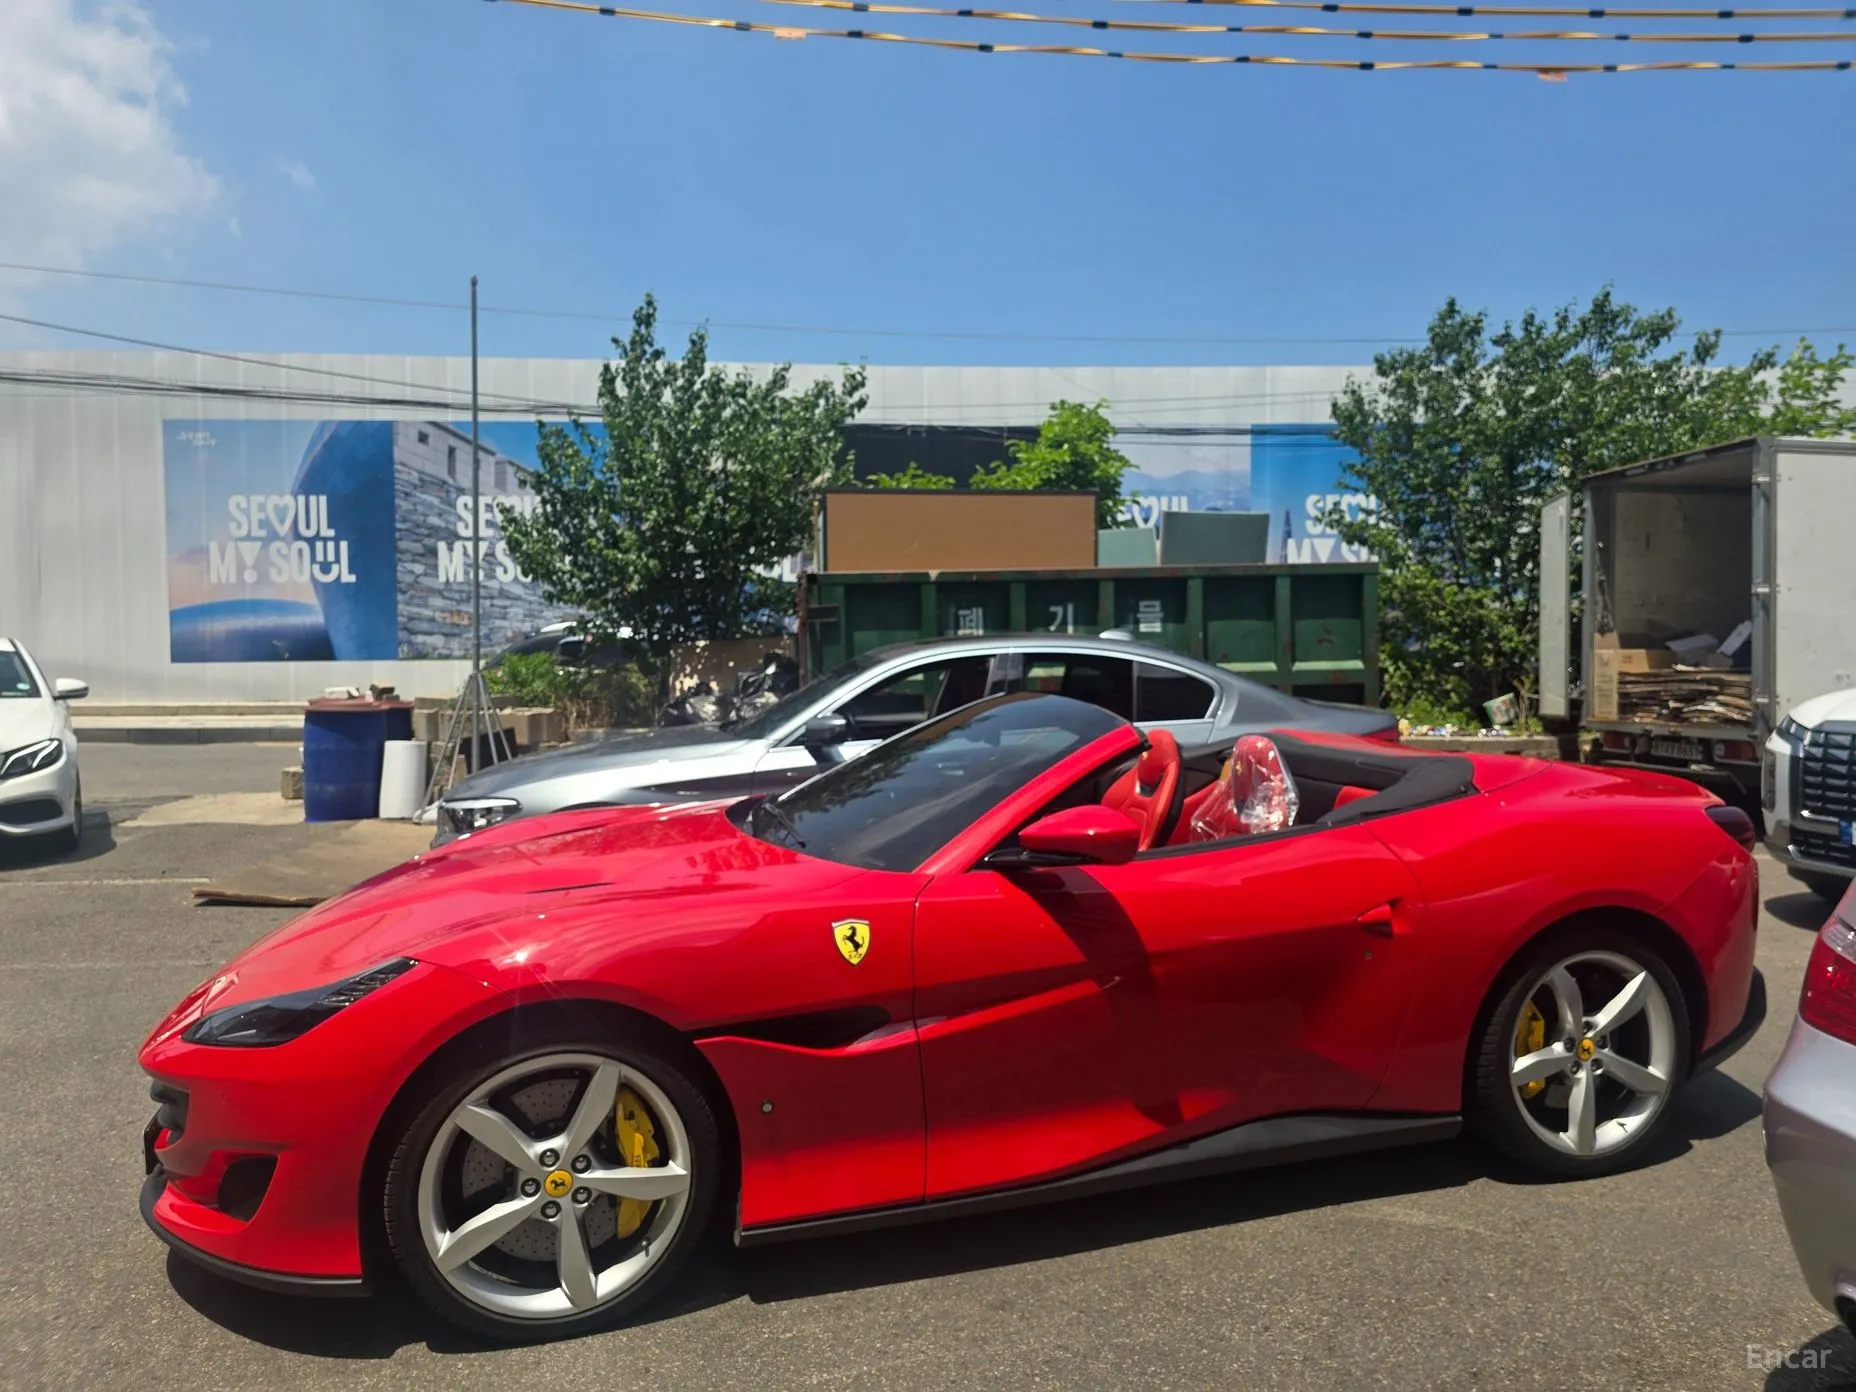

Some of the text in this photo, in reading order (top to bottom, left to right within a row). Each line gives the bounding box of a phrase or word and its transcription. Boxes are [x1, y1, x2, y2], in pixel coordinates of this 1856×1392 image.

[228, 494, 336, 538] SEOUL
[209, 540, 357, 584] MY SOUL
